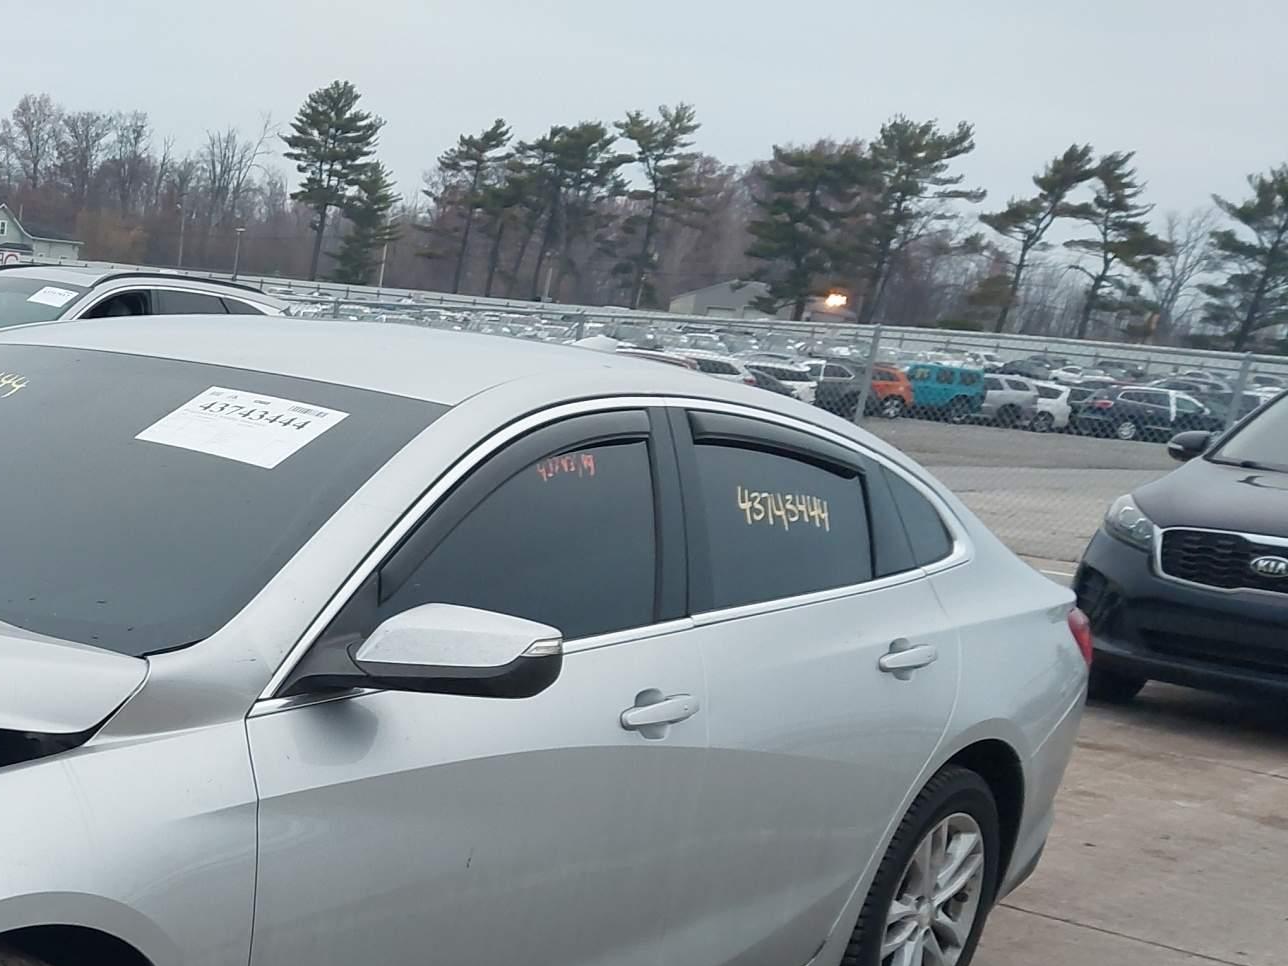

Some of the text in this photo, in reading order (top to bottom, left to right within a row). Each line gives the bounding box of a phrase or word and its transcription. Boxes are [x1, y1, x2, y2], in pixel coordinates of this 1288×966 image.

[199, 400, 312, 430] 43743444
[737, 486, 830, 532] 43743444
[1257, 559, 1287, 574] KIA
